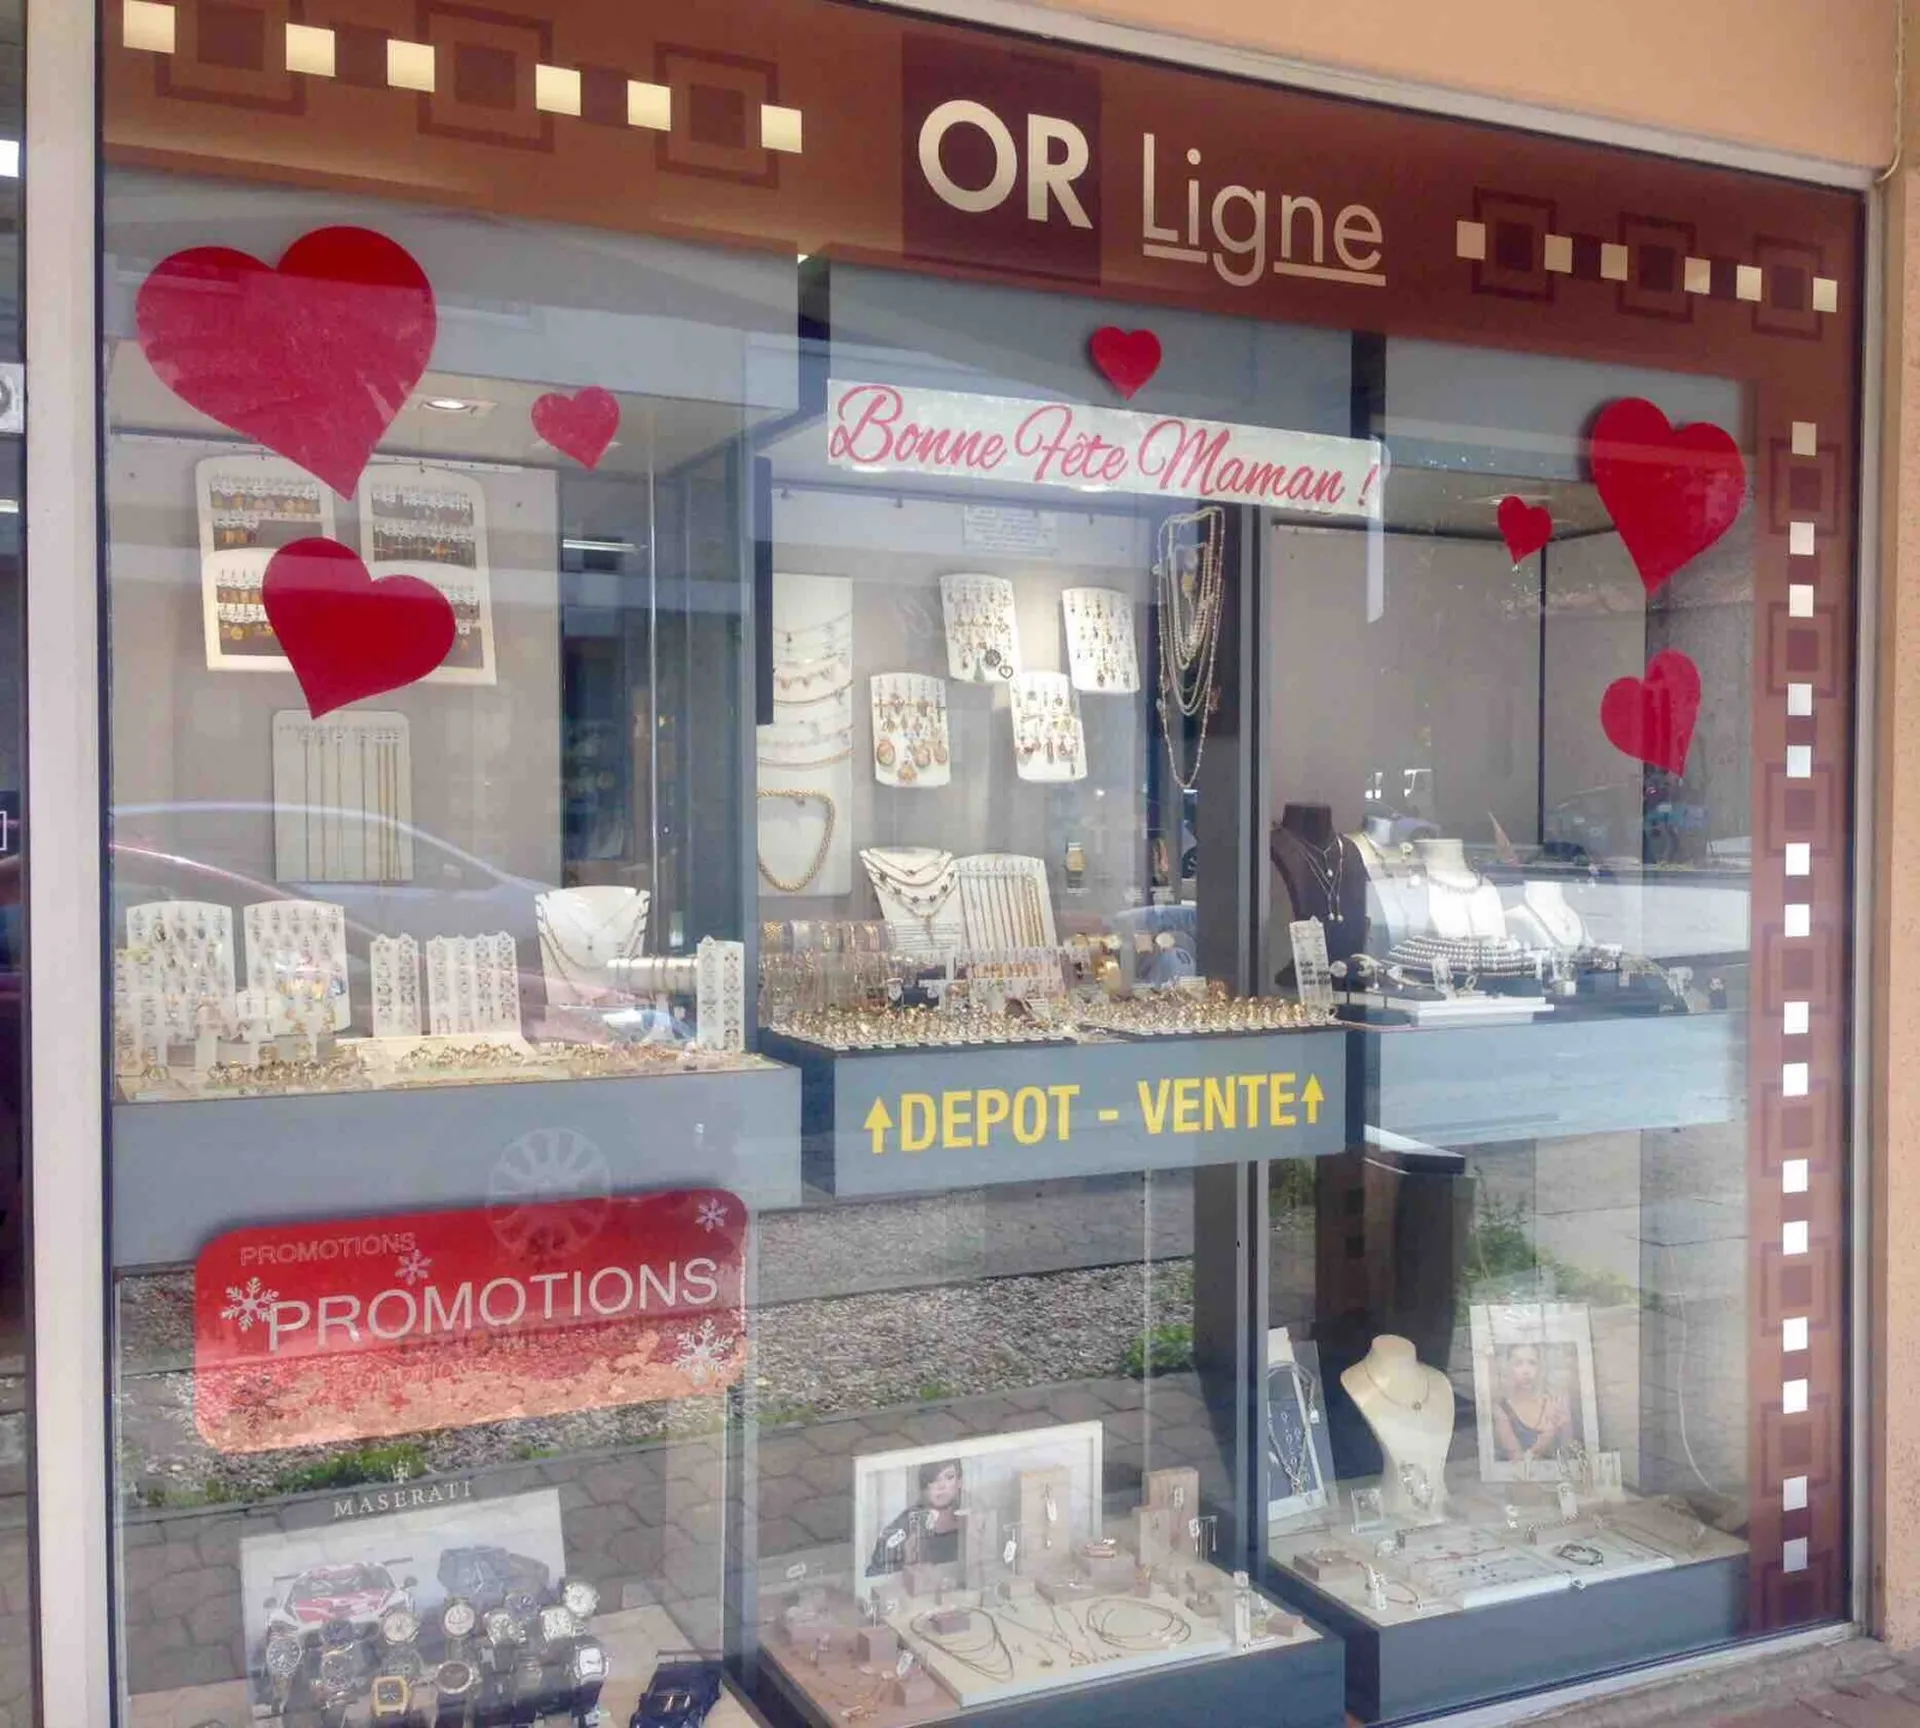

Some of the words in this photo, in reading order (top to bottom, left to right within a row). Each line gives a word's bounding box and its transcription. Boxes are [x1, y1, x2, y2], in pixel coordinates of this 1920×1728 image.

[918, 100, 1094, 229] OR
[1143, 133, 1386, 287] Ligne
[830, 384, 1006, 471] Bonne
[1015, 405, 1130, 482] Fête
[1138, 419, 1345, 505] Maman
[900, 1084, 1081, 1152] DEPOT
[1137, 1072, 1297, 1135] VENTE
[240, 1231, 416, 1267] PROMOTIONS
[268, 1257, 719, 1354] PROMOTIONS
[334, 1480, 473, 1518] MASERATI
